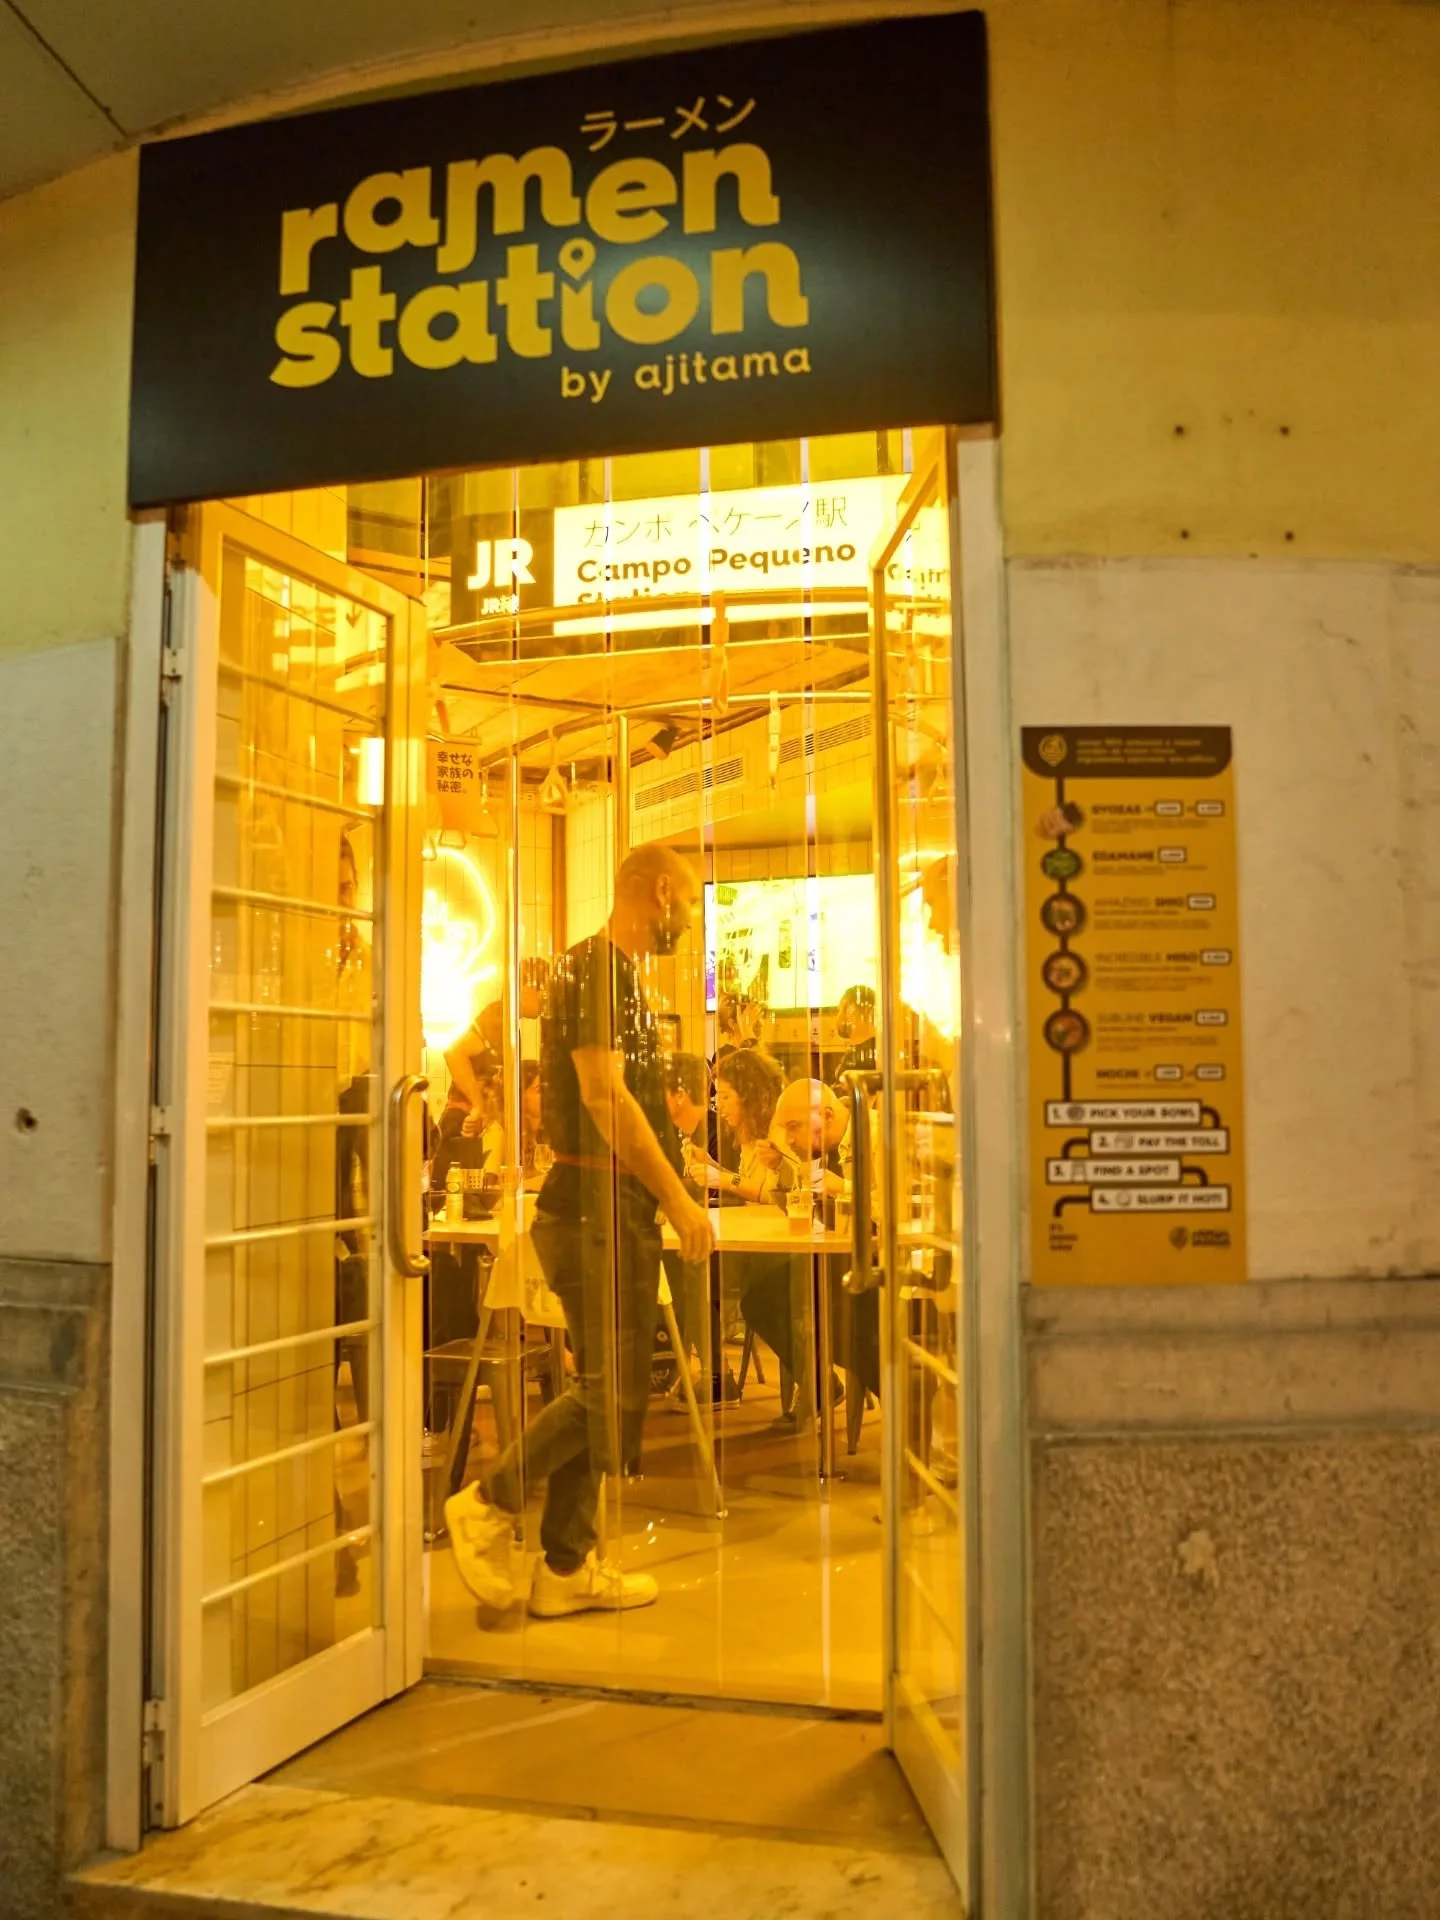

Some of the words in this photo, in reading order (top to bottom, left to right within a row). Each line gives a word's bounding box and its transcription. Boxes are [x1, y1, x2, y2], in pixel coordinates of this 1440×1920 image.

[580, 95, 756, 152] ラーメン
[279, 142, 781, 296] ramen
[269, 239, 810, 389] station
[561, 366, 613, 404] by
[634, 346, 812, 396] ajitama
[467, 537, 537, 592] JR
[577, 556, 692, 584] Campo
[708, 543, 857, 574] Pequeno
[437, 751, 473, 767] 幸せな
[437, 765, 474, 780] 家族の
[1089, 1108, 1118, 1119] PICK
[1123, 1107, 1156, 1118] YOUR
[1138, 1137, 1161, 1148] PAY
[1165, 1136, 1187, 1147] THE
[1093, 1165, 1122, 1176] FIND
[1125, 1165, 1134, 1175] A
[1138, 1165, 1171, 1176] SPOT
[1136, 1194, 1175, 1205] SLURP
[1178, 1194, 1188, 1204] IT
